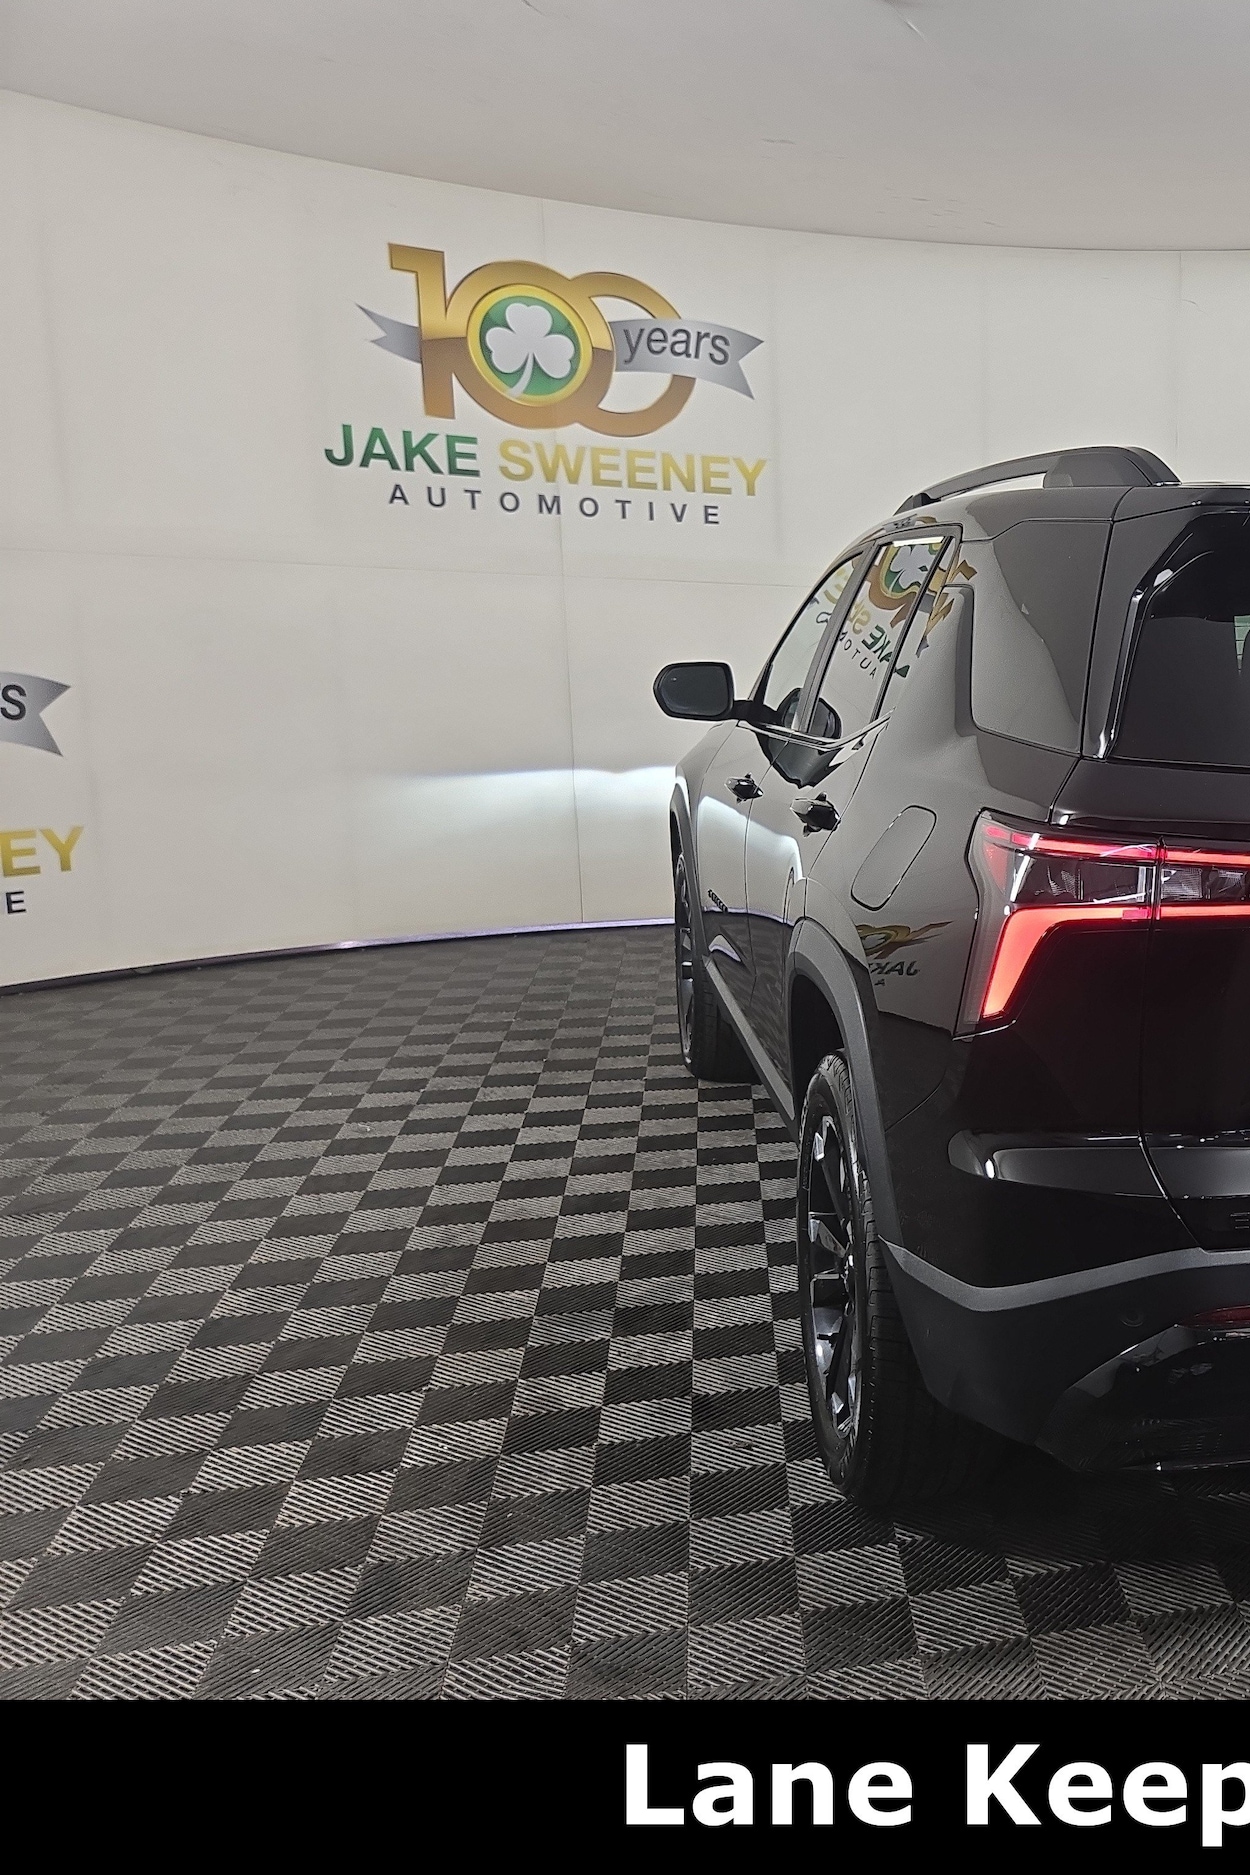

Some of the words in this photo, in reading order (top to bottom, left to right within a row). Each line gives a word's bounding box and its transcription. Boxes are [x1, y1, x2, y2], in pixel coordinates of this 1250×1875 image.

[623, 325, 731, 366] years
[324, 423, 481, 477] JAKE
[499, 439, 767, 497] SWEENEY
[389, 484, 720, 524] AUTOMOTIVE
